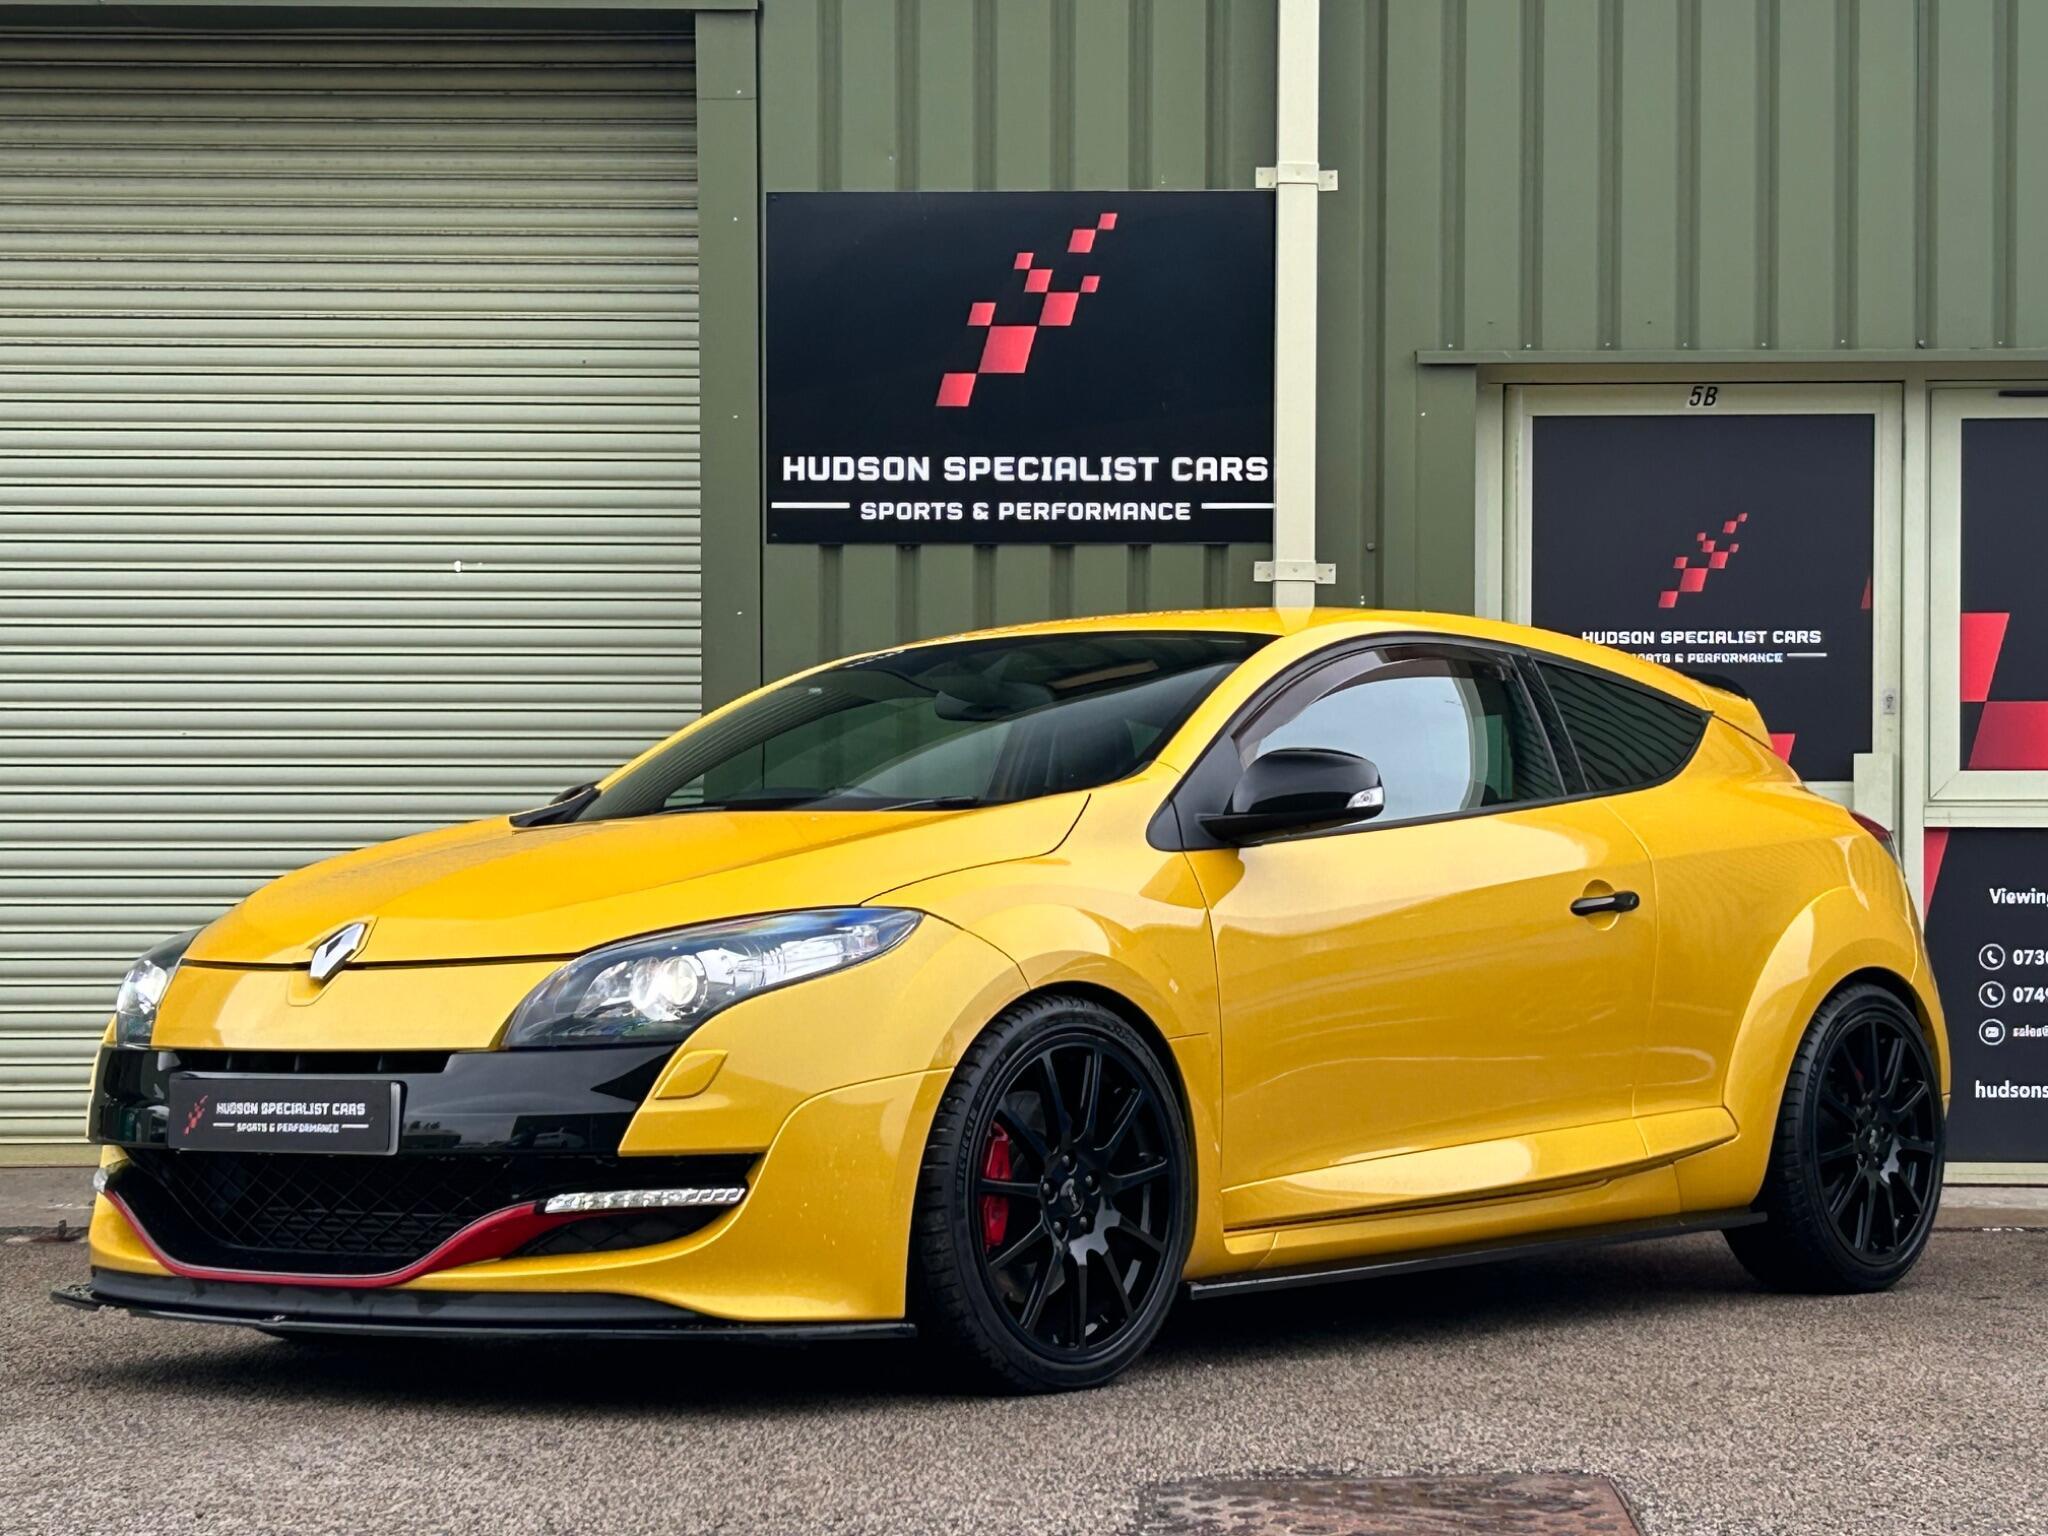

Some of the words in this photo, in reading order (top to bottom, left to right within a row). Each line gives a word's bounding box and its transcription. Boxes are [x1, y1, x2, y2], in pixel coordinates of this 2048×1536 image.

[1689, 386, 1718, 406] 5B
[783, 456, 930, 481] HUDSON
[943, 456, 1160, 482] SPECIALIST
[1171, 456, 1269, 482] CARS
[860, 502, 963, 521] SPORTS
[973, 502, 990, 521] &
[999, 502, 1192, 521] PERFORMANCE
[1582, 630, 1655, 645] HUDSON
[1660, 630, 1768, 644] SPECIALIST
[1772, 630, 1822, 644] CARS
[1674, 652, 1684, 664] &
[1688, 652, 1784, 664] PERFORMANCE
[1989, 887, 2048, 908] Viewin
[2013, 949, 2048, 966] 073
[216, 1102, 259, 1116] HUDSON
[261, 1102, 330, 1116] SPECIALIST
[331, 1102, 366, 1116] CARS
